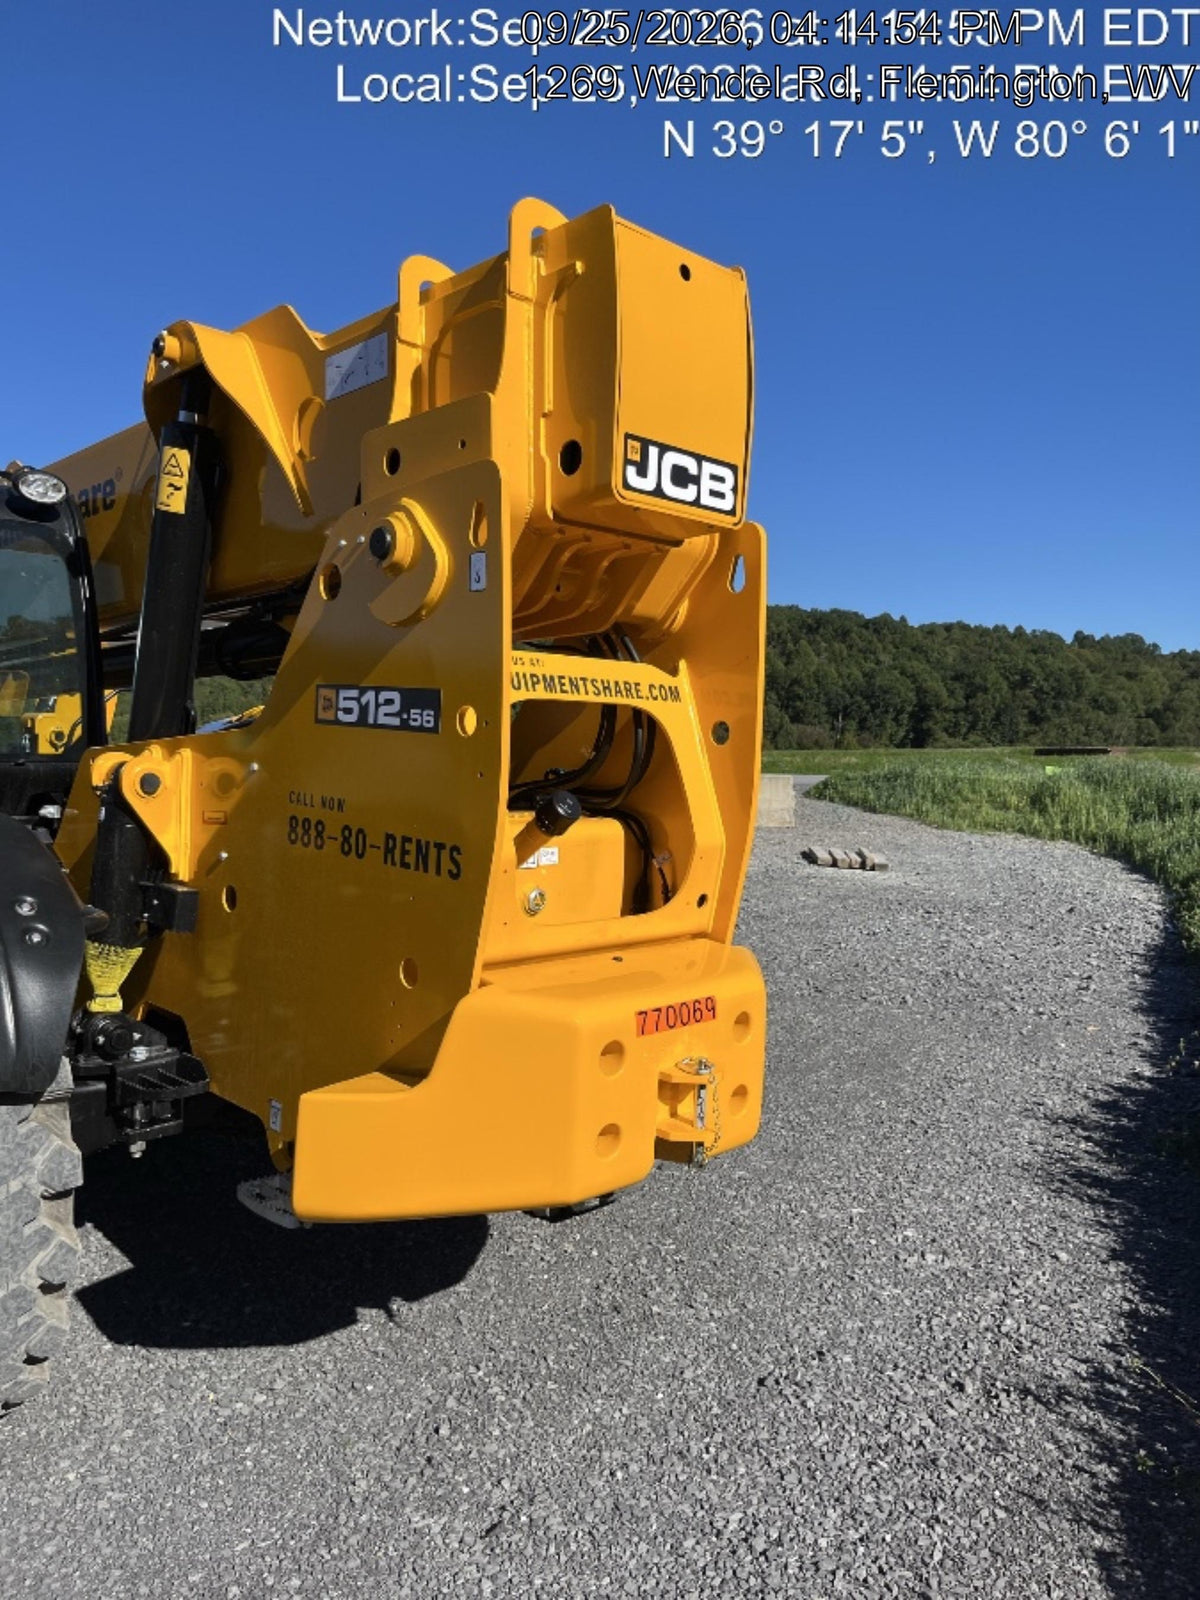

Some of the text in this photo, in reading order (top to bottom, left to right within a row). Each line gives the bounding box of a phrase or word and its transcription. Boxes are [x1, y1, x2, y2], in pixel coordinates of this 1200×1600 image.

[73, 478, 116, 518] are
[625, 444, 735, 512] JCB
[289, 790, 346, 813] CALL NOW
[287, 815, 463, 881] 888-80-RENTS
[637, 996, 716, 1036] 770069
